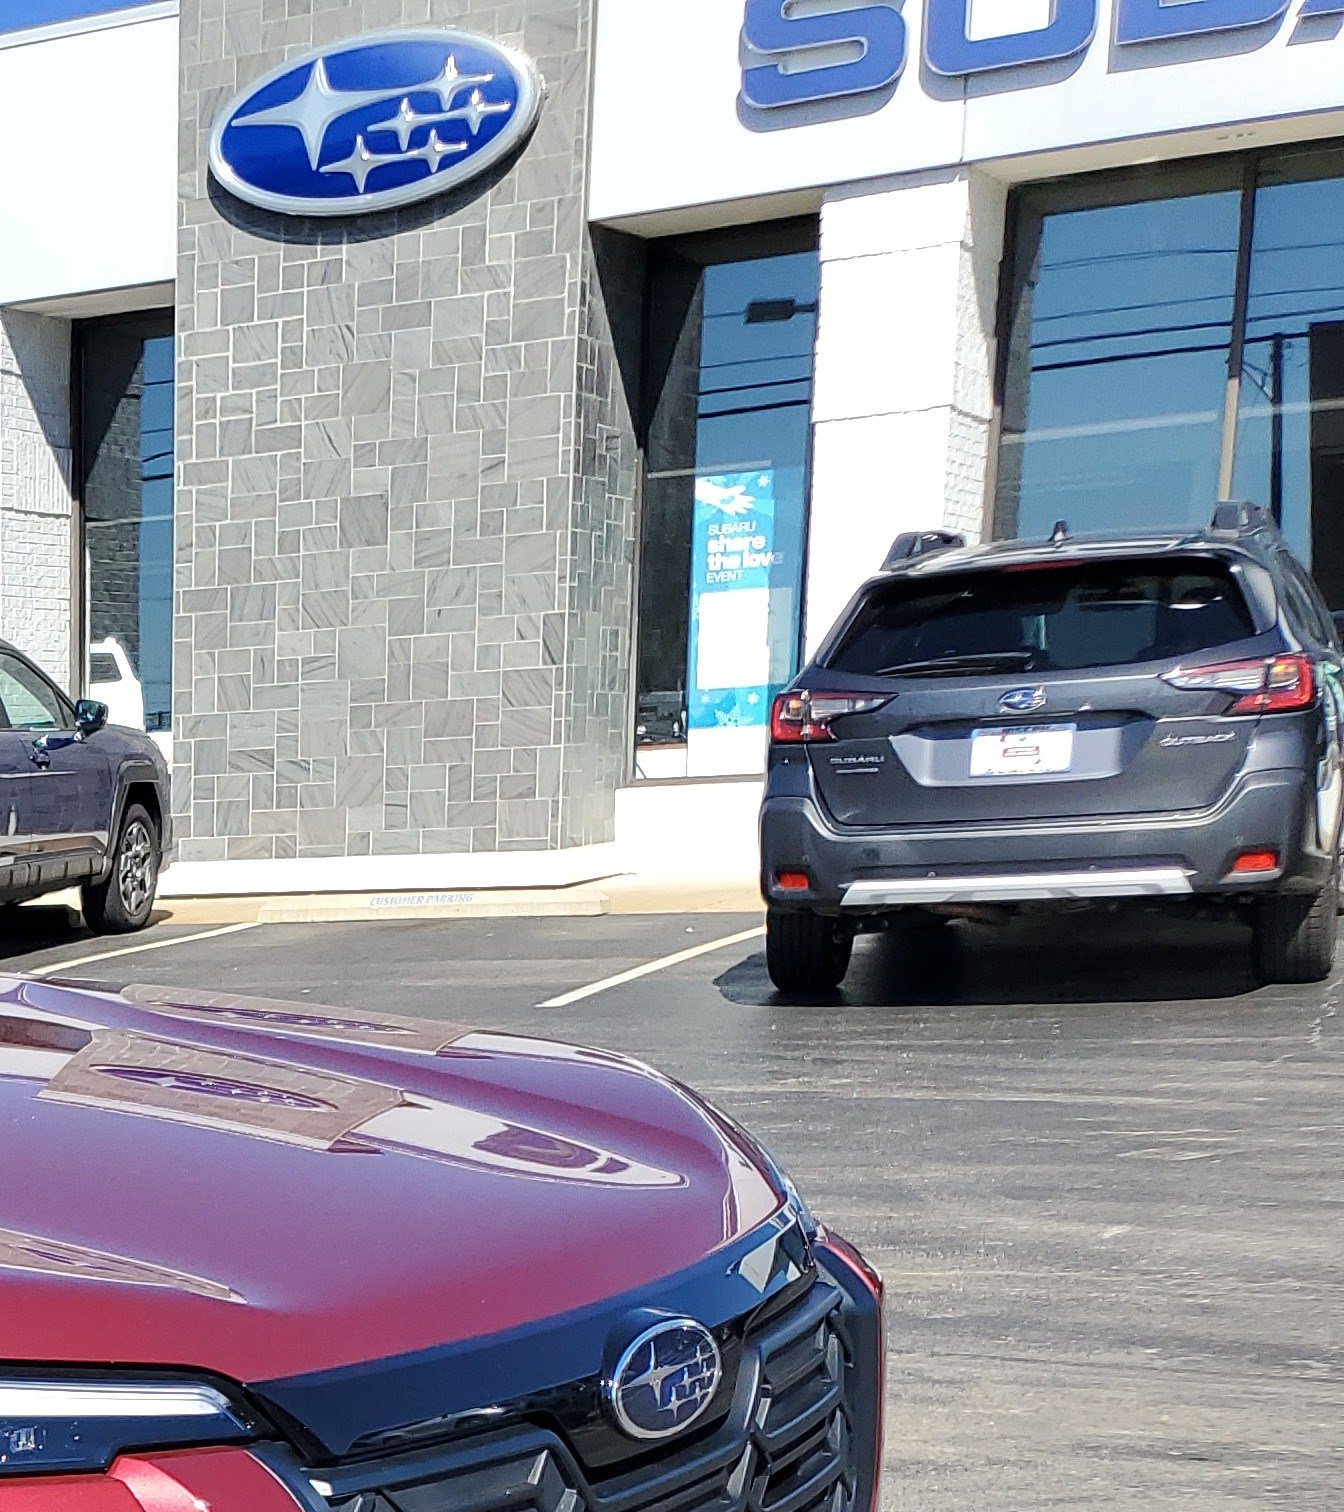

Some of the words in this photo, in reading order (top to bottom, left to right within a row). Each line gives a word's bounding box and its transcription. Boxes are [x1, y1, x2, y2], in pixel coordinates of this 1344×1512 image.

[740, 0, 1344, 110] SU
[707, 521, 757, 536] SUBARU
[706, 535, 767, 554] share
[707, 553, 741, 571] the
[743, 551, 784, 568] love
[706, 570, 743, 584] EVENT
